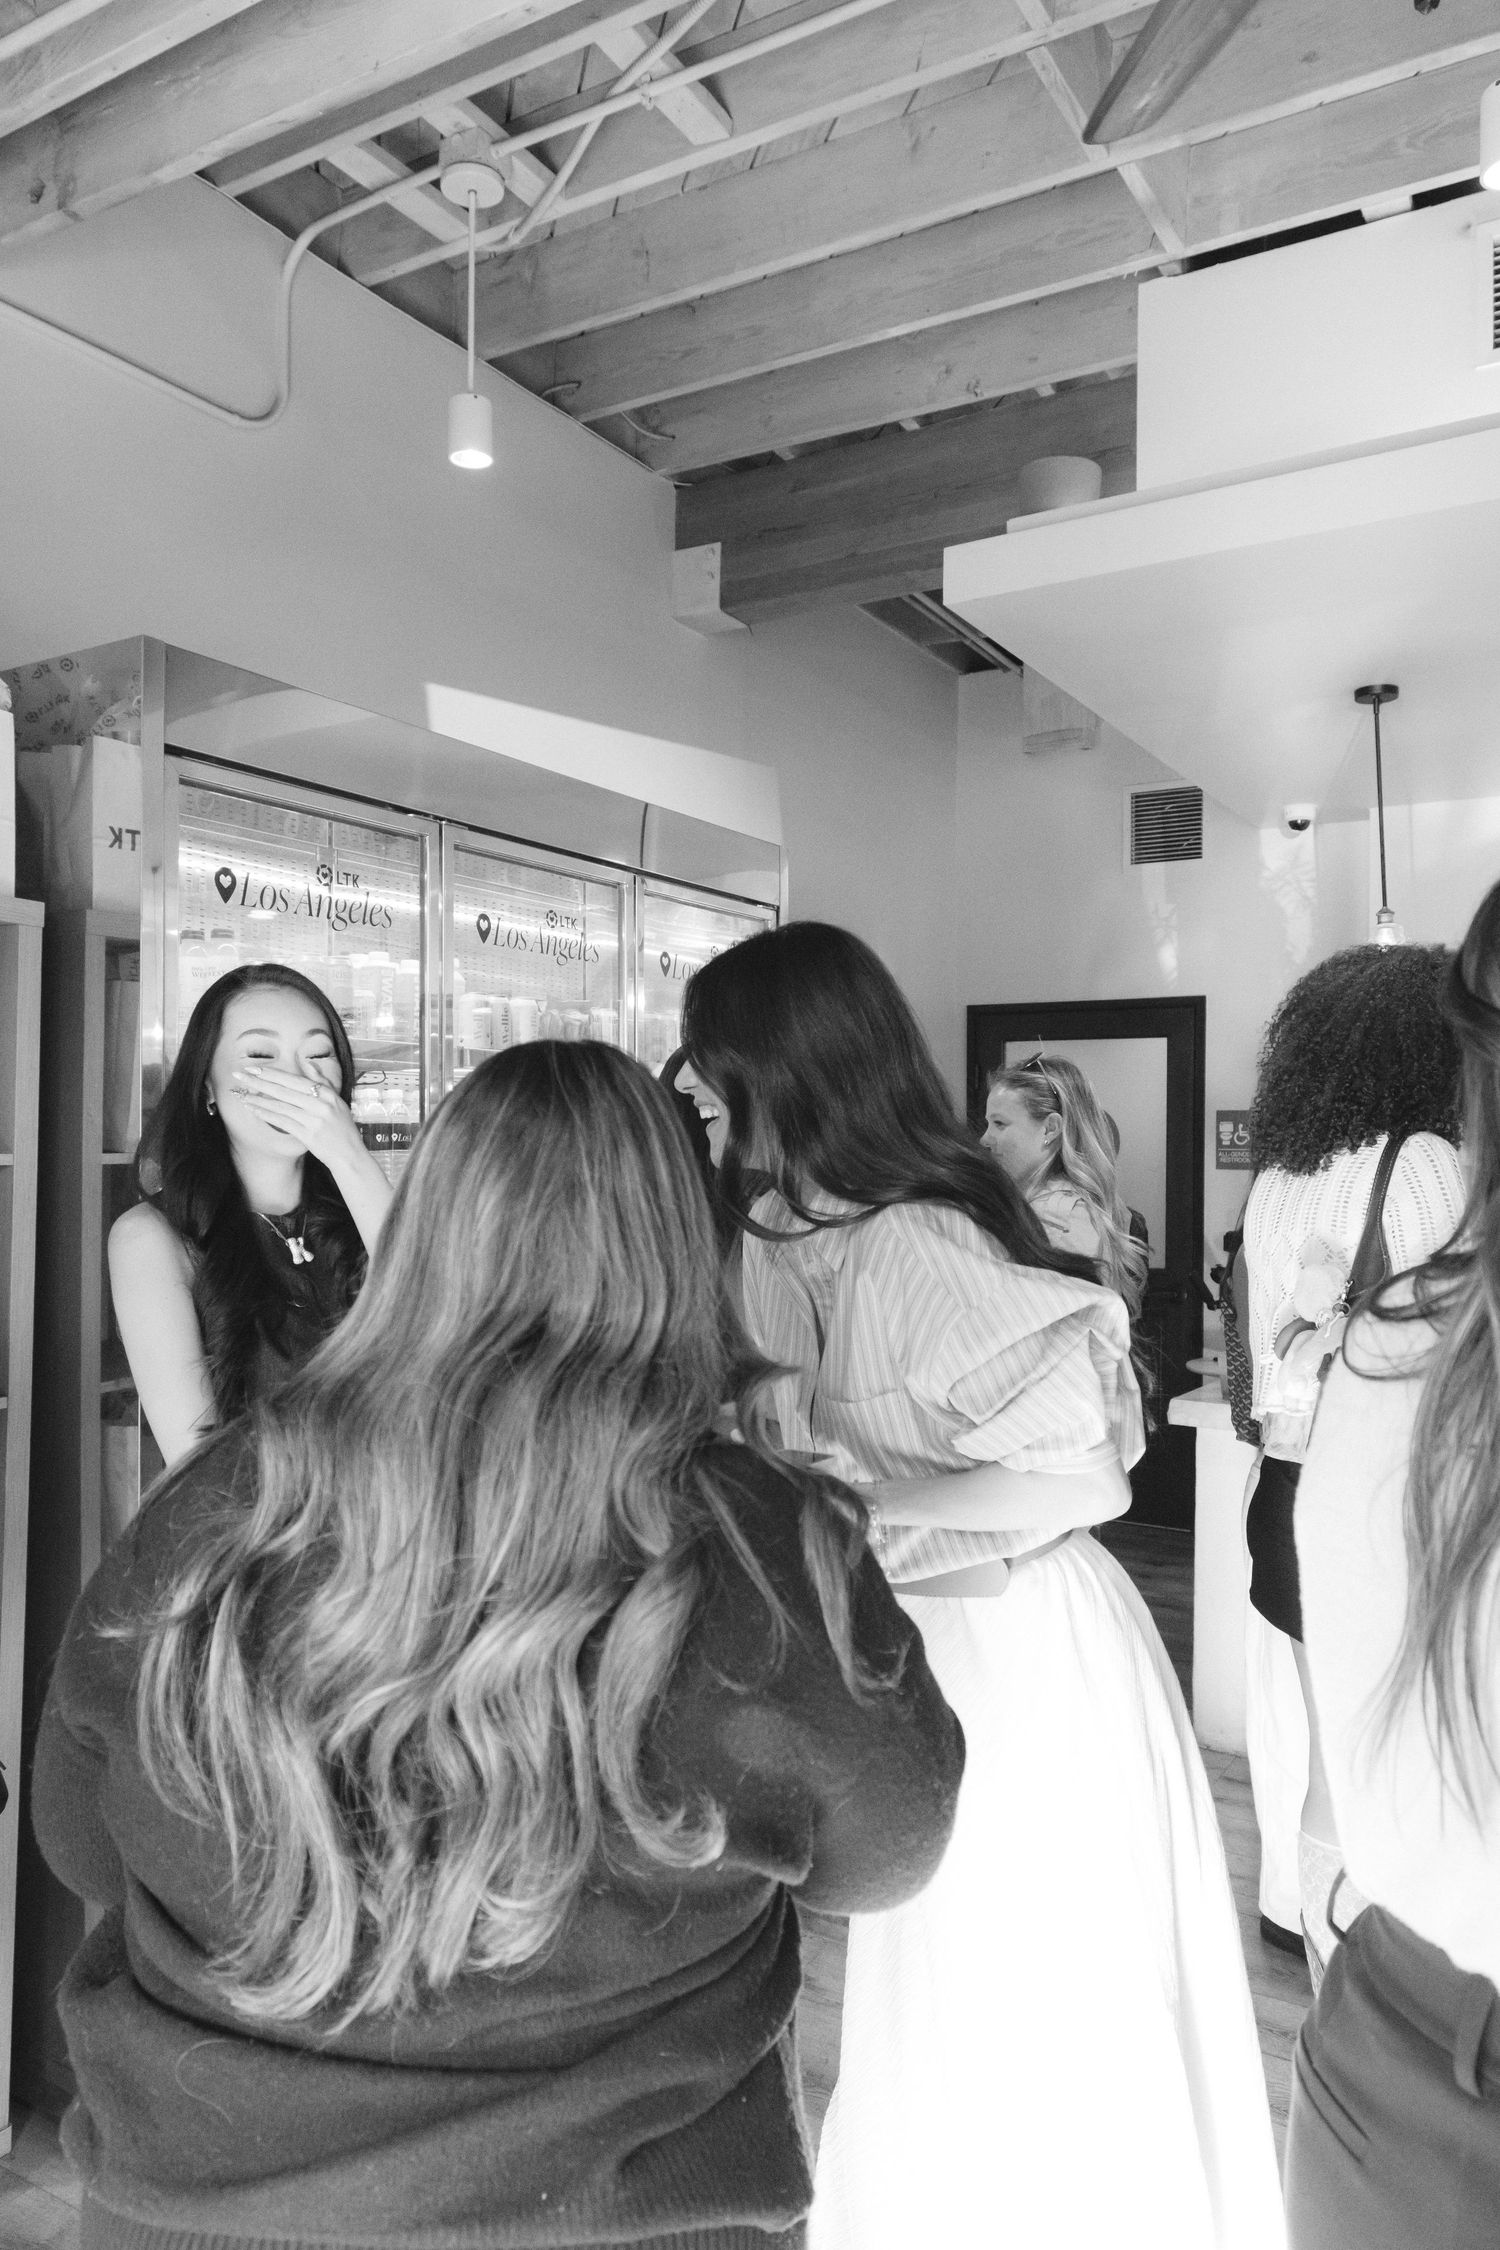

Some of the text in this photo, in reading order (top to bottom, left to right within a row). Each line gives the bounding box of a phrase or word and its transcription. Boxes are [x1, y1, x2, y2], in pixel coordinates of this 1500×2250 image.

[336, 870, 361, 889] LTK
[239, 871, 394, 932] Los Angeles
[559, 915, 578, 931] LTK
[492, 916, 601, 966] Los Angeles
